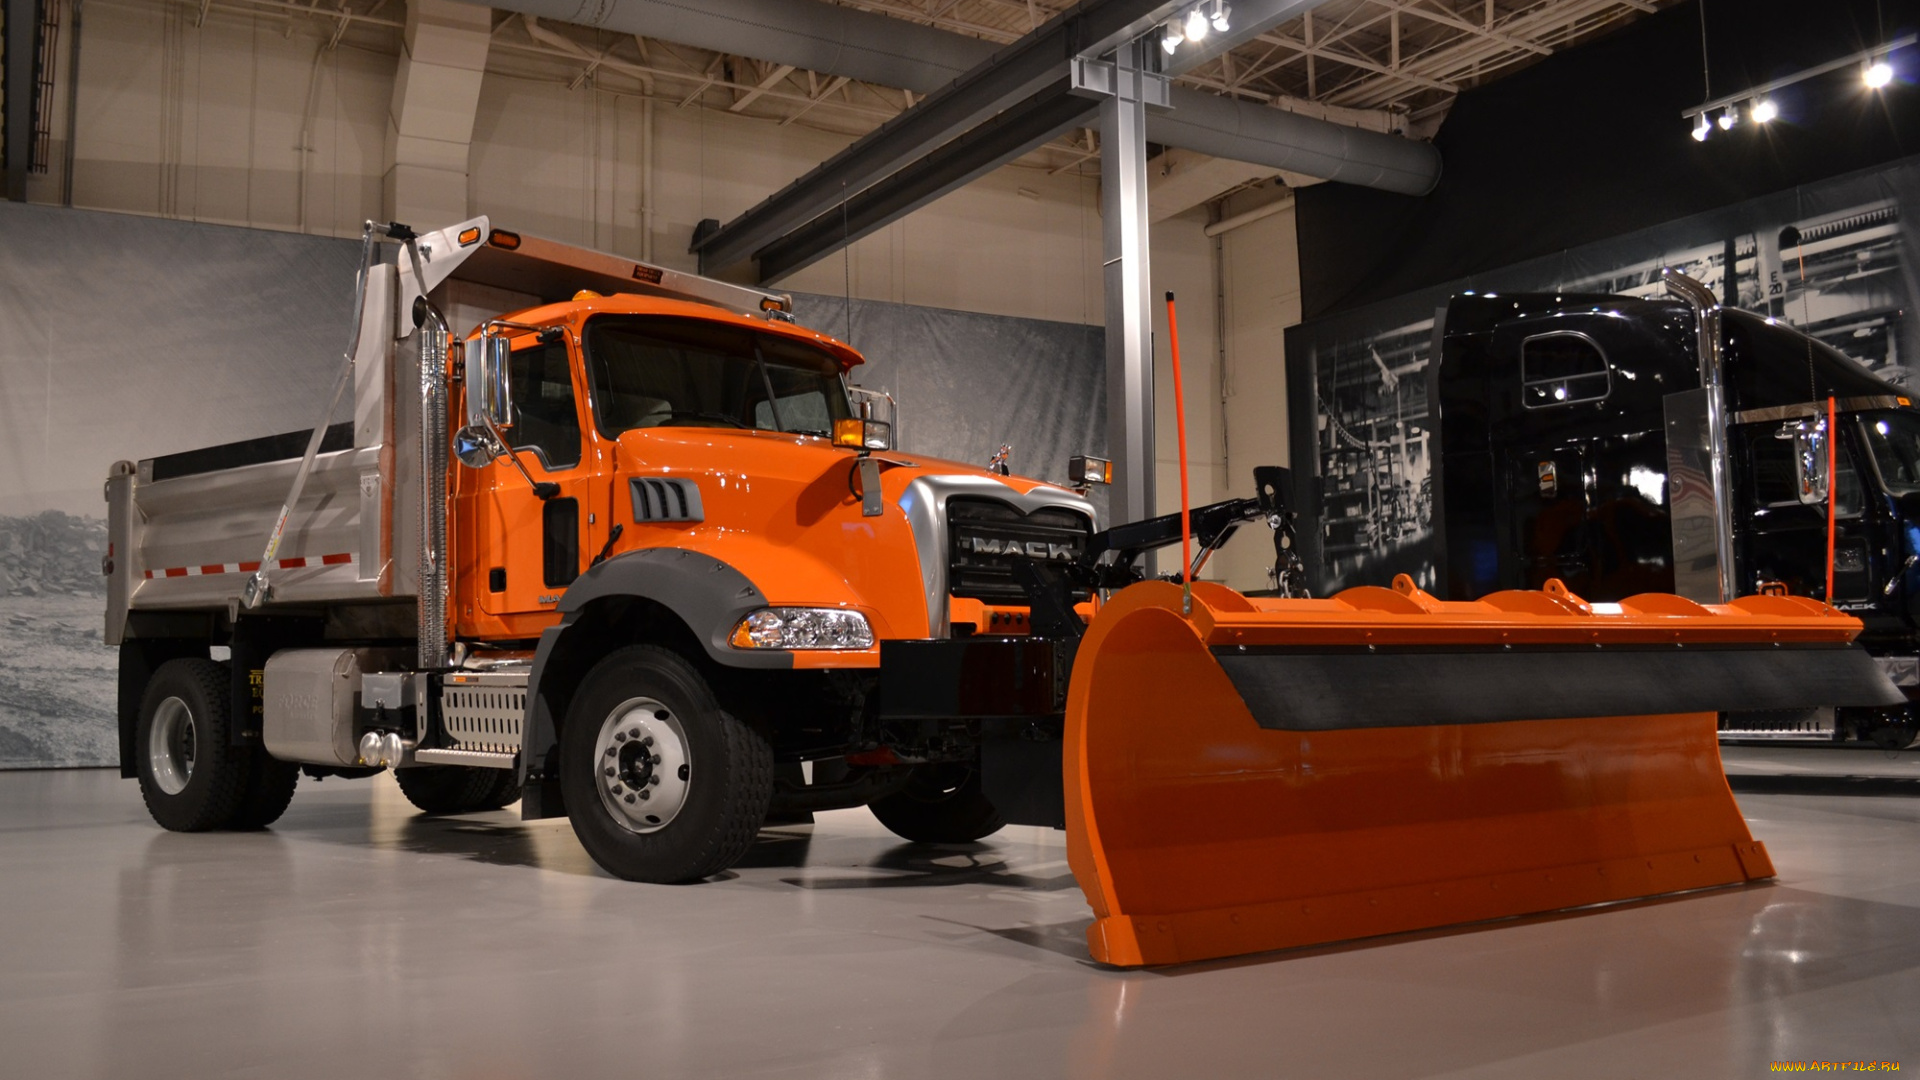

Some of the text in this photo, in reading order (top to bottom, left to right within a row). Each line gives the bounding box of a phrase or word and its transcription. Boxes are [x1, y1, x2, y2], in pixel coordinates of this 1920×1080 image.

[1770, 271, 1778, 283] E
[1768, 283, 1783, 295] 20
[972, 536, 1073, 560] MACK
